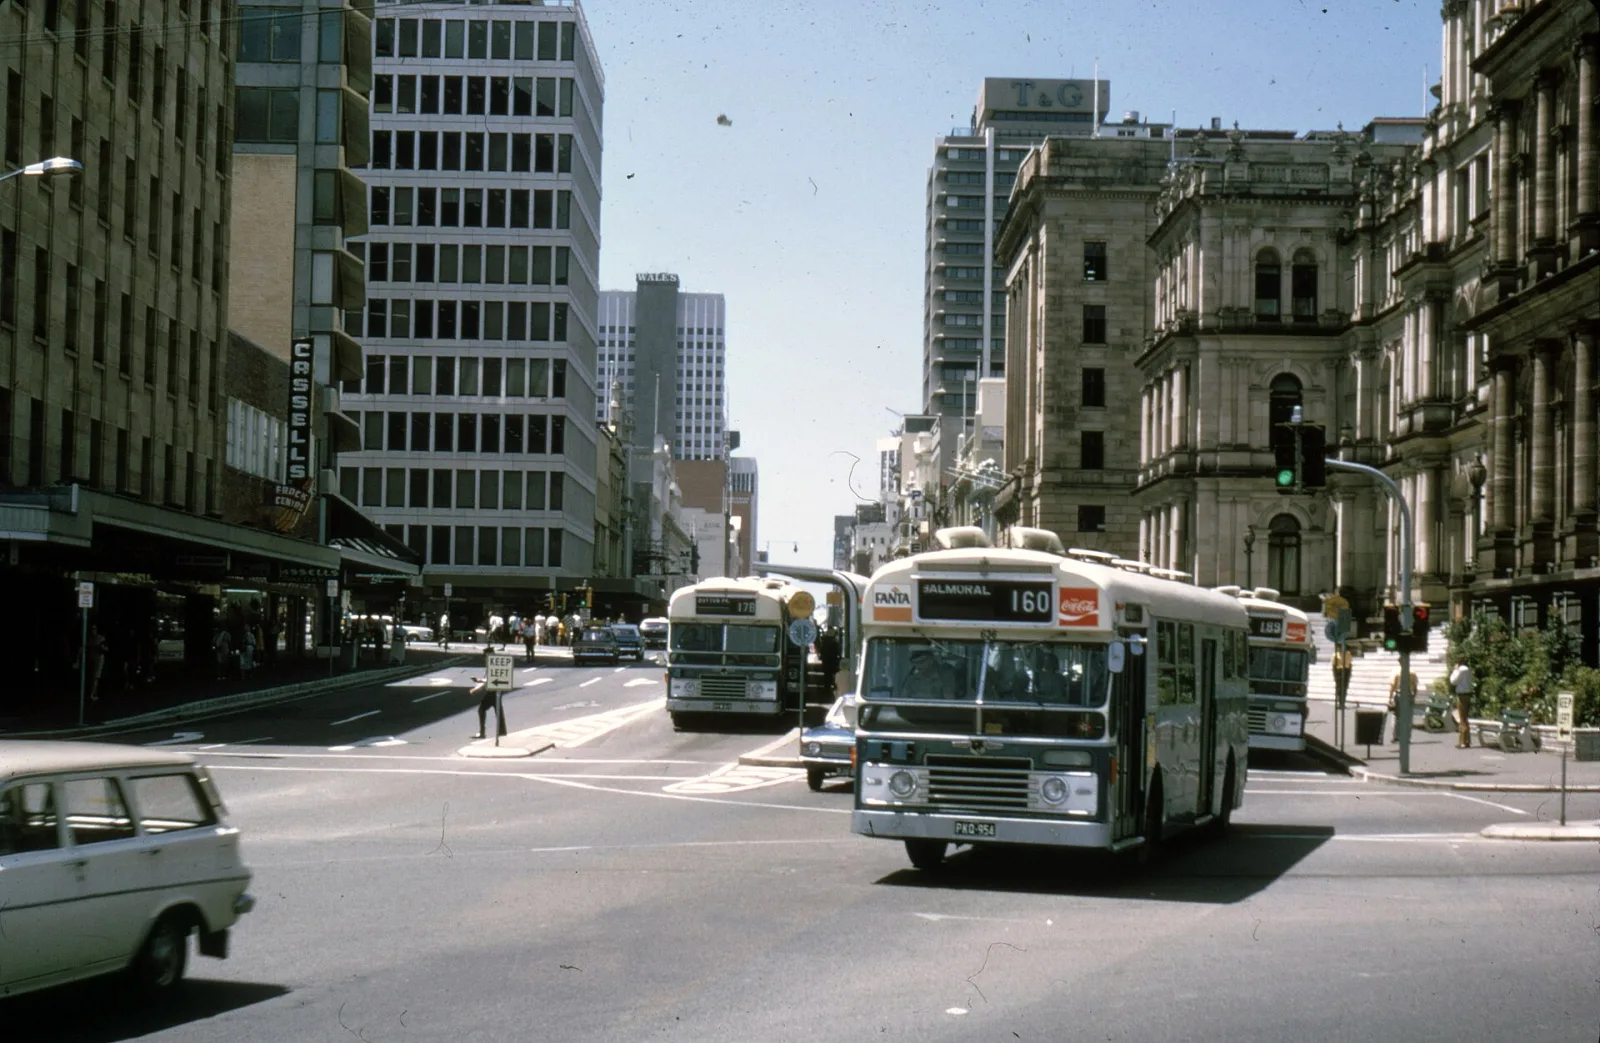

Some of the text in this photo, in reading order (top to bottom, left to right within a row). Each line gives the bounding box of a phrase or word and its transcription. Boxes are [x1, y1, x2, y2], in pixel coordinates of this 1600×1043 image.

[637, 272, 678, 282] WALES
[290, 342, 311, 479] CASSELLS
[275, 484, 308, 501] FROCK
[923, 584, 991, 597] BALMORAL
[875, 591, 910, 607] FANTA
[1011, 590, 1050, 613] 160
[1260, 621, 1281, 634] 189
[490, 657, 511, 666] KEEP
[491, 668, 509, 677] LEFT
